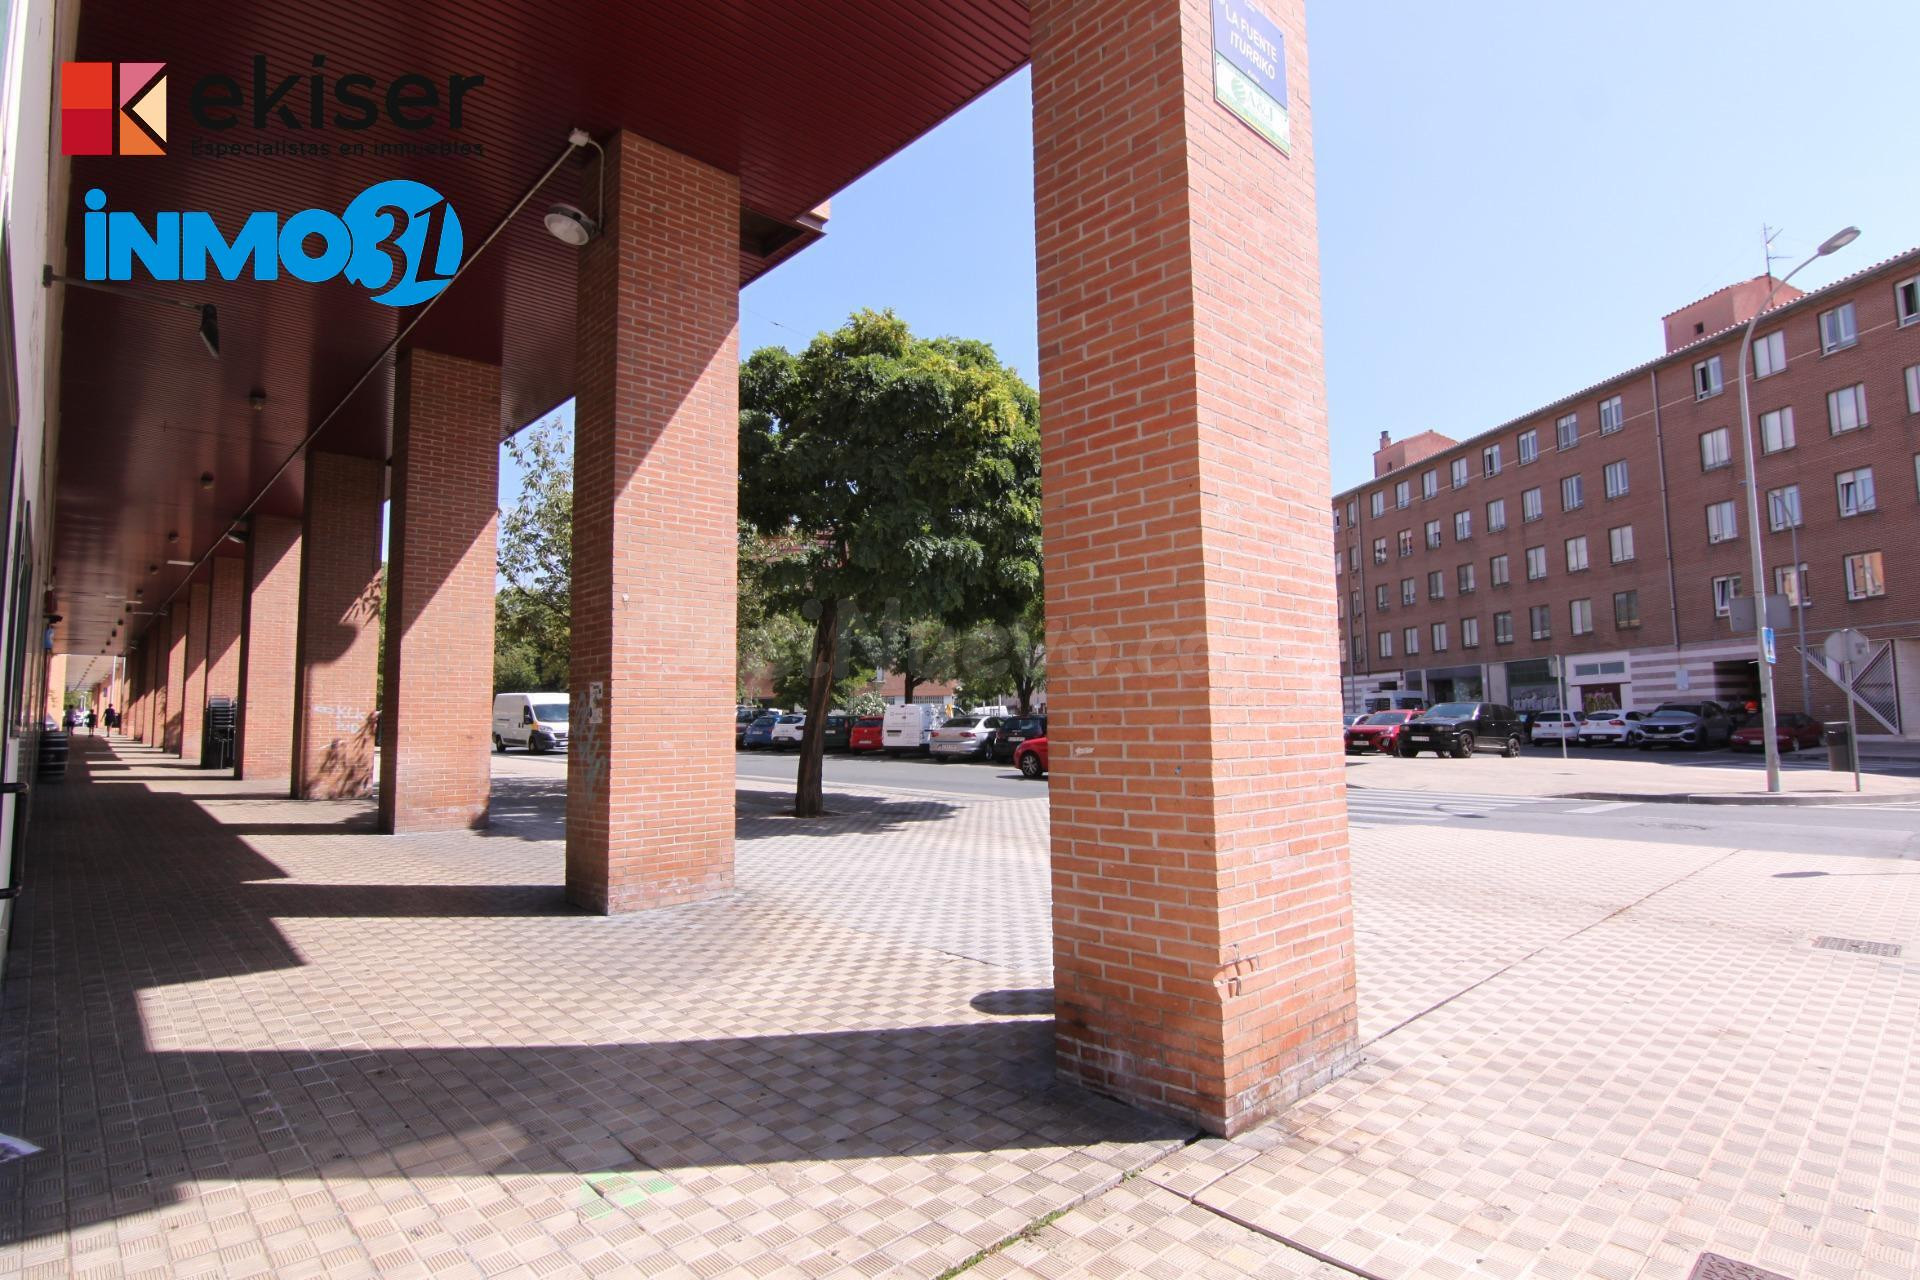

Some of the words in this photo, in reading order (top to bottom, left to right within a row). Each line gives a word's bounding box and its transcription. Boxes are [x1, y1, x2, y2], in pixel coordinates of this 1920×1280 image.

[1225, 3, 1239, 28] LA
[1241, 19, 1278, 63] FUENTE
[1230, 31, 1276, 80] ITURRIKO
